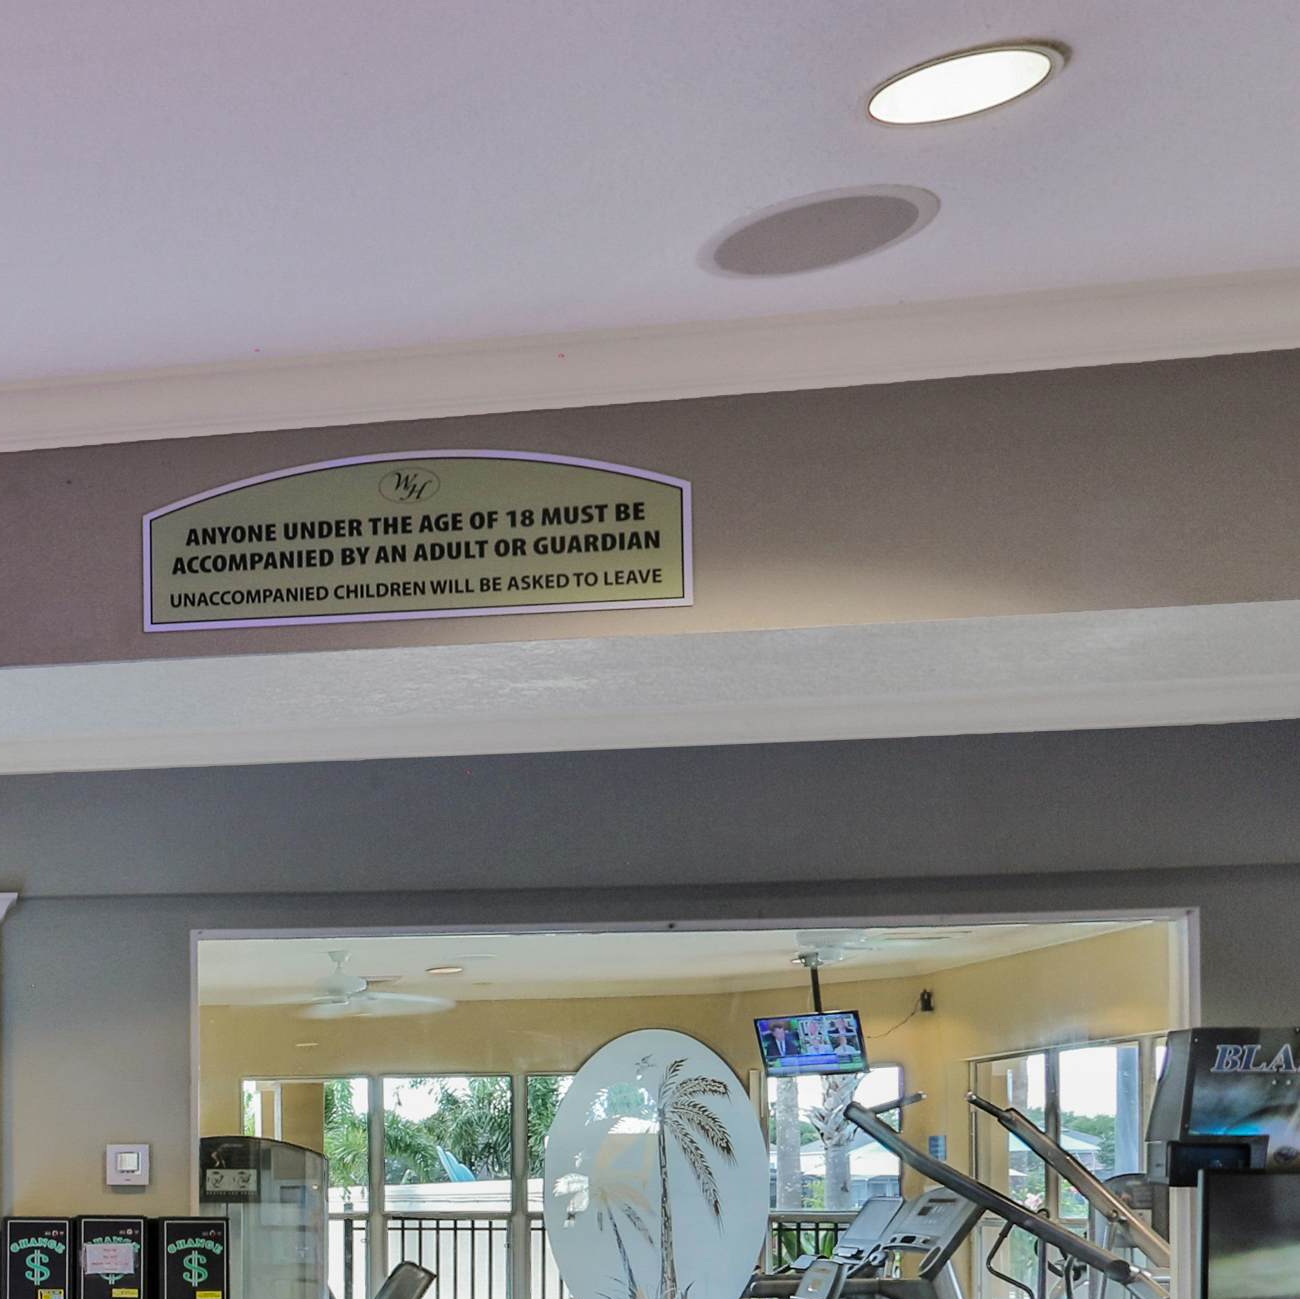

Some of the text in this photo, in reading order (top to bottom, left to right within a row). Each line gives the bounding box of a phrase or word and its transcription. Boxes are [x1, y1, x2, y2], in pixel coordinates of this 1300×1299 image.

[186, 502, 645, 546] ANYONE UNDER THE AGE OF 18 MUST BE
[172, 531, 660, 575] ACCOMPANIED BY AN ADULT OR GUARDIAN
[170, 568, 662, 608] UNACCOMPANIED CHILDREN WILL BE ASKED TO LEAVE
[1210, 1043, 1300, 1073] BLA
[10, 1237, 66, 1254] CHANGE
[167, 1238, 223, 1255] CHANGE
